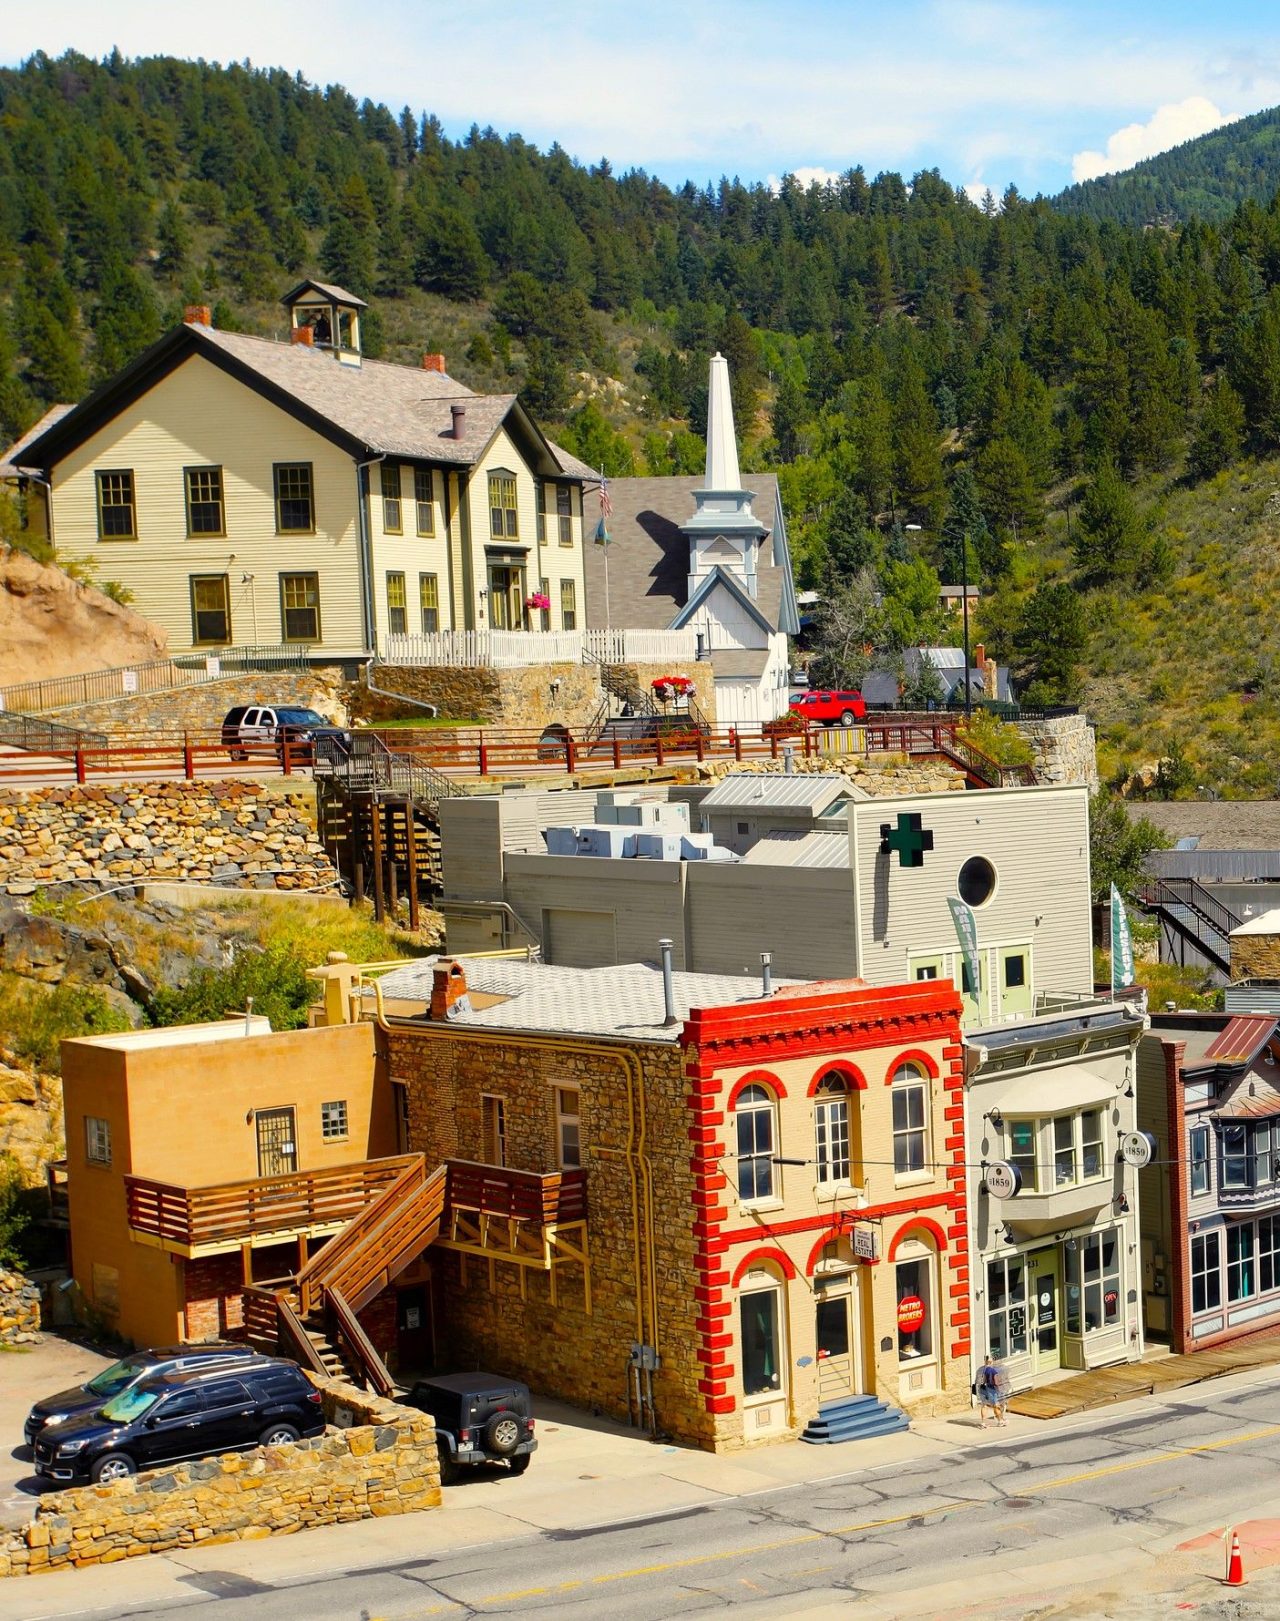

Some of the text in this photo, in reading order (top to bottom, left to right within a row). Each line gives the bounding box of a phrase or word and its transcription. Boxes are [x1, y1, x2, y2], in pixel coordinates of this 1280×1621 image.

[1129, 1147, 1146, 1156] 1859
[992, 1178, 1010, 1187] 1859
[857, 1238, 870, 1248] REAL
[855, 1246, 872, 1257] ESTATE
[1104, 1291, 1117, 1302] OPEN
[900, 1301, 921, 1312] METRO
[898, 1310, 923, 1321] BROKERS
